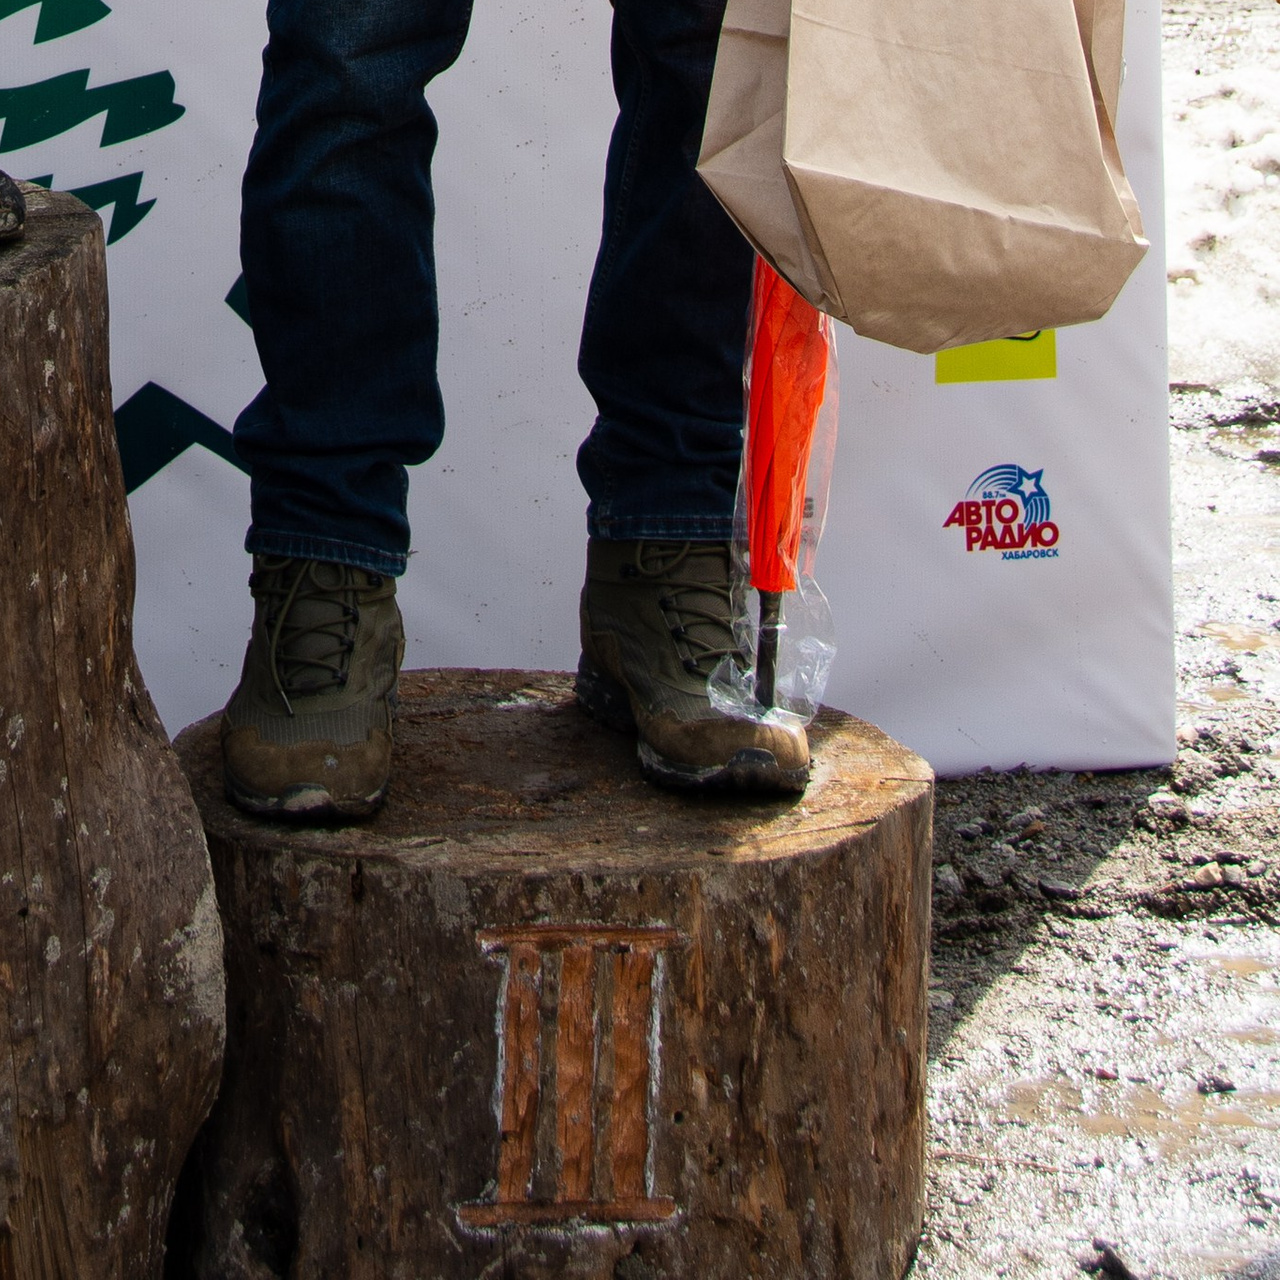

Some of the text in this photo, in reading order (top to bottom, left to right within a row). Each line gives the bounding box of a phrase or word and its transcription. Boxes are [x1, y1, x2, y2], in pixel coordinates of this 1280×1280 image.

[942, 498, 1019, 528] АВТО
[965, 521, 1060, 552] РАДИО
[1001, 548, 1059, 560] ХАБАРОВСК
